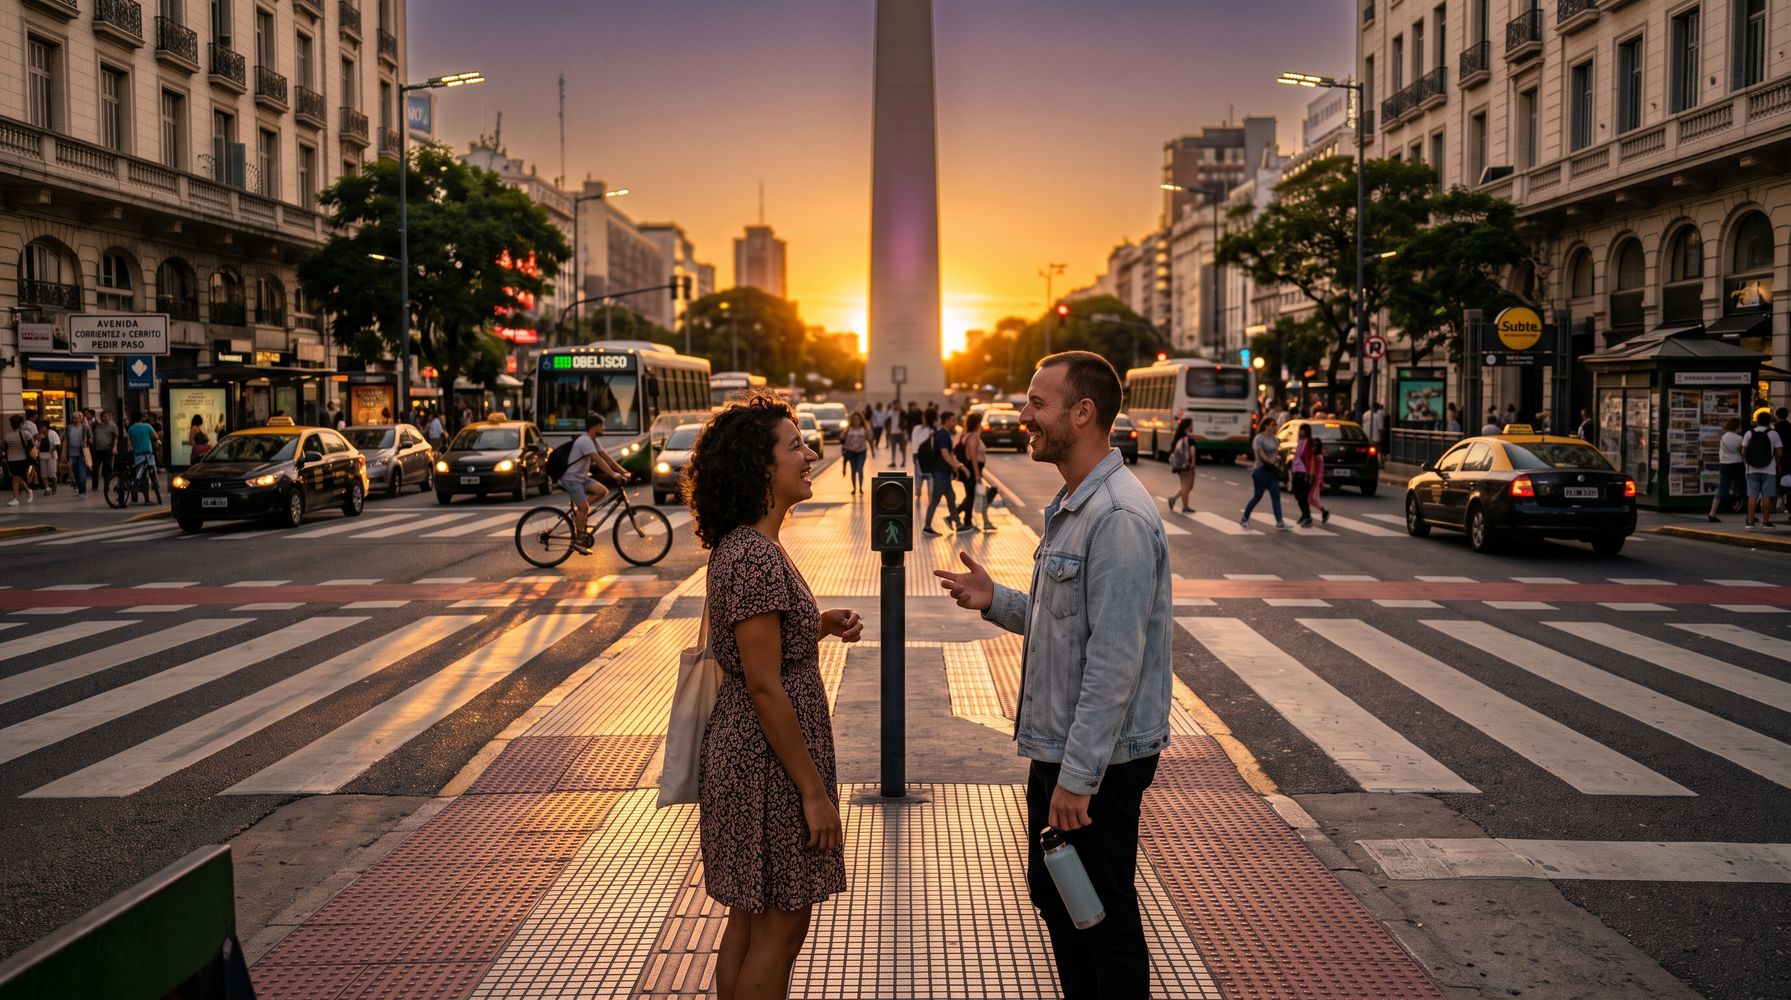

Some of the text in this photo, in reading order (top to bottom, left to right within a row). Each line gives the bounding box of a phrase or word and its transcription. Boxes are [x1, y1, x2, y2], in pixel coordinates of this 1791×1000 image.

[97, 320, 139, 328] AVENIDA
[1502, 321, 1538, 332] Subte
[75, 330, 161, 338] CORRIENTEZ CERRITO
[91, 341, 145, 349] PEDIR PASO
[572, 355, 628, 369] OBELISCO
